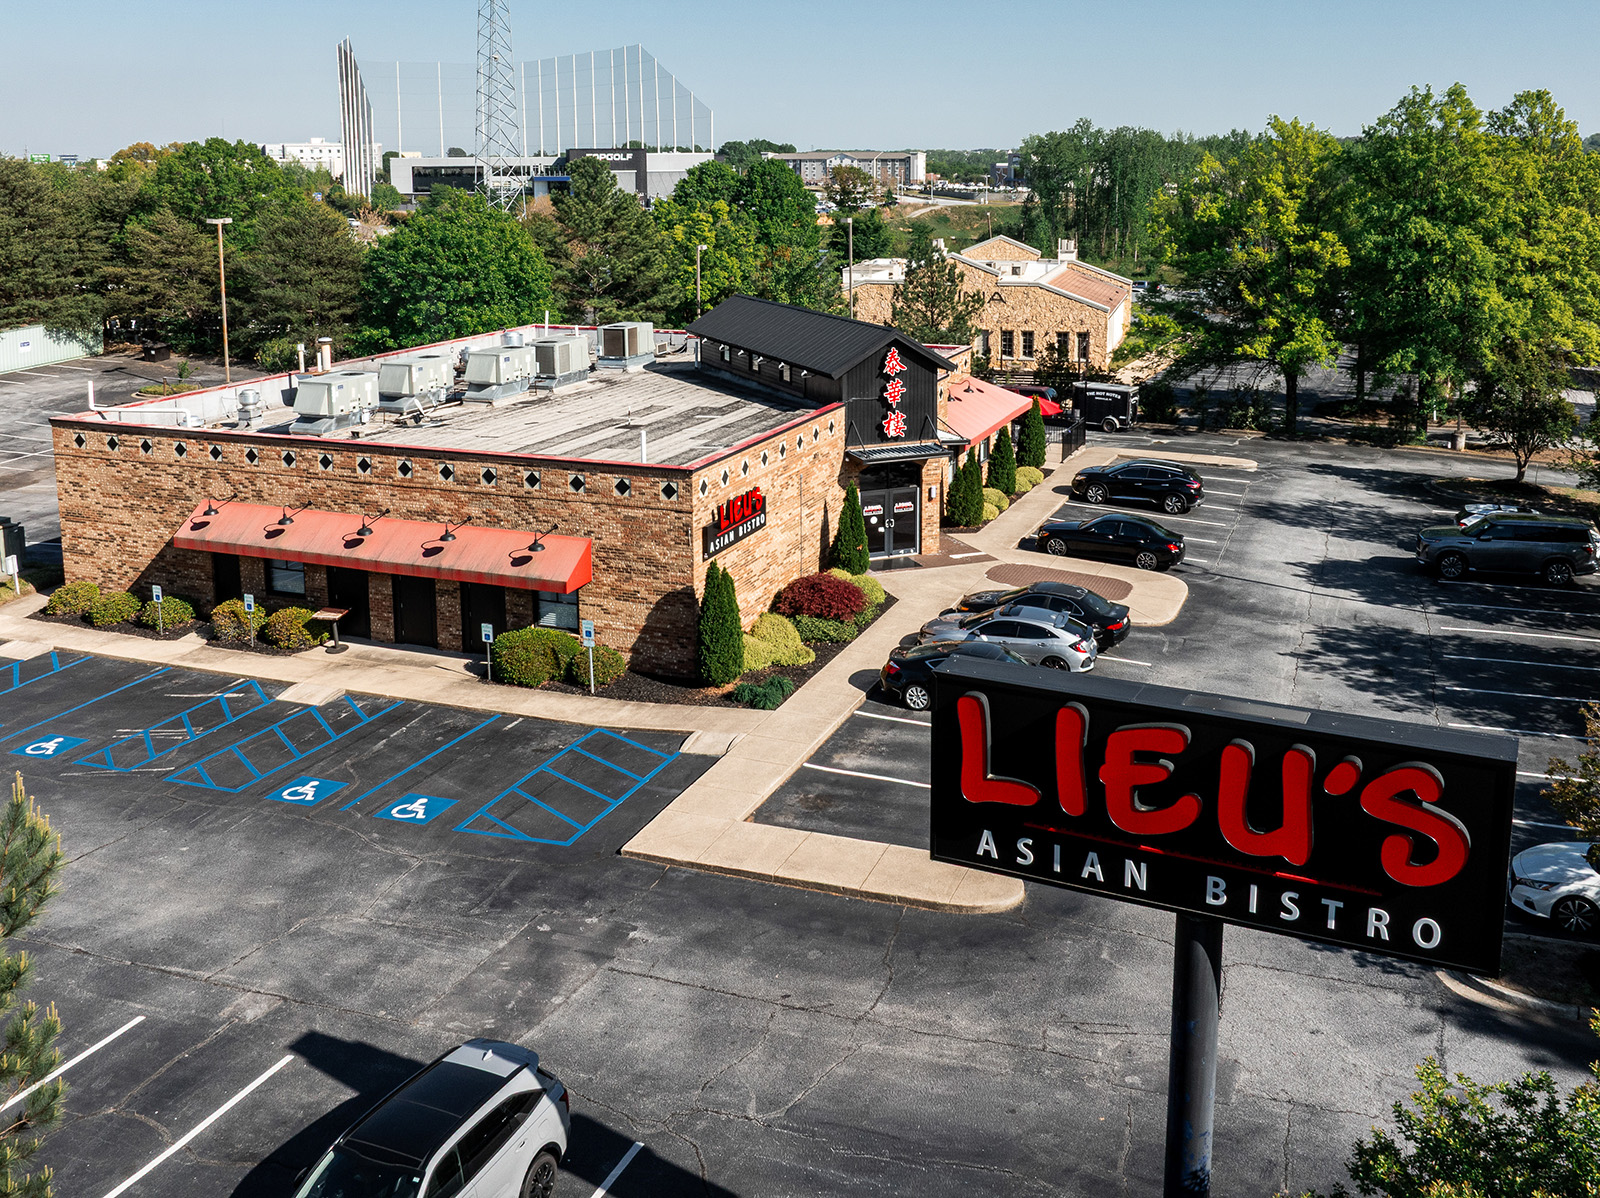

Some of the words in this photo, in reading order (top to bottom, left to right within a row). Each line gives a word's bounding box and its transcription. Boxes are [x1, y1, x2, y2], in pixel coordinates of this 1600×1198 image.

[883, 347, 907, 437] 泰華樓
[709, 530, 735, 553] ASIAN
[739, 513, 765, 537] BISTRO
[957, 691, 1470, 887] LIEU'S
[976, 829, 1147, 892] ASIAN
[1205, 875, 1442, 949] BISTRO
